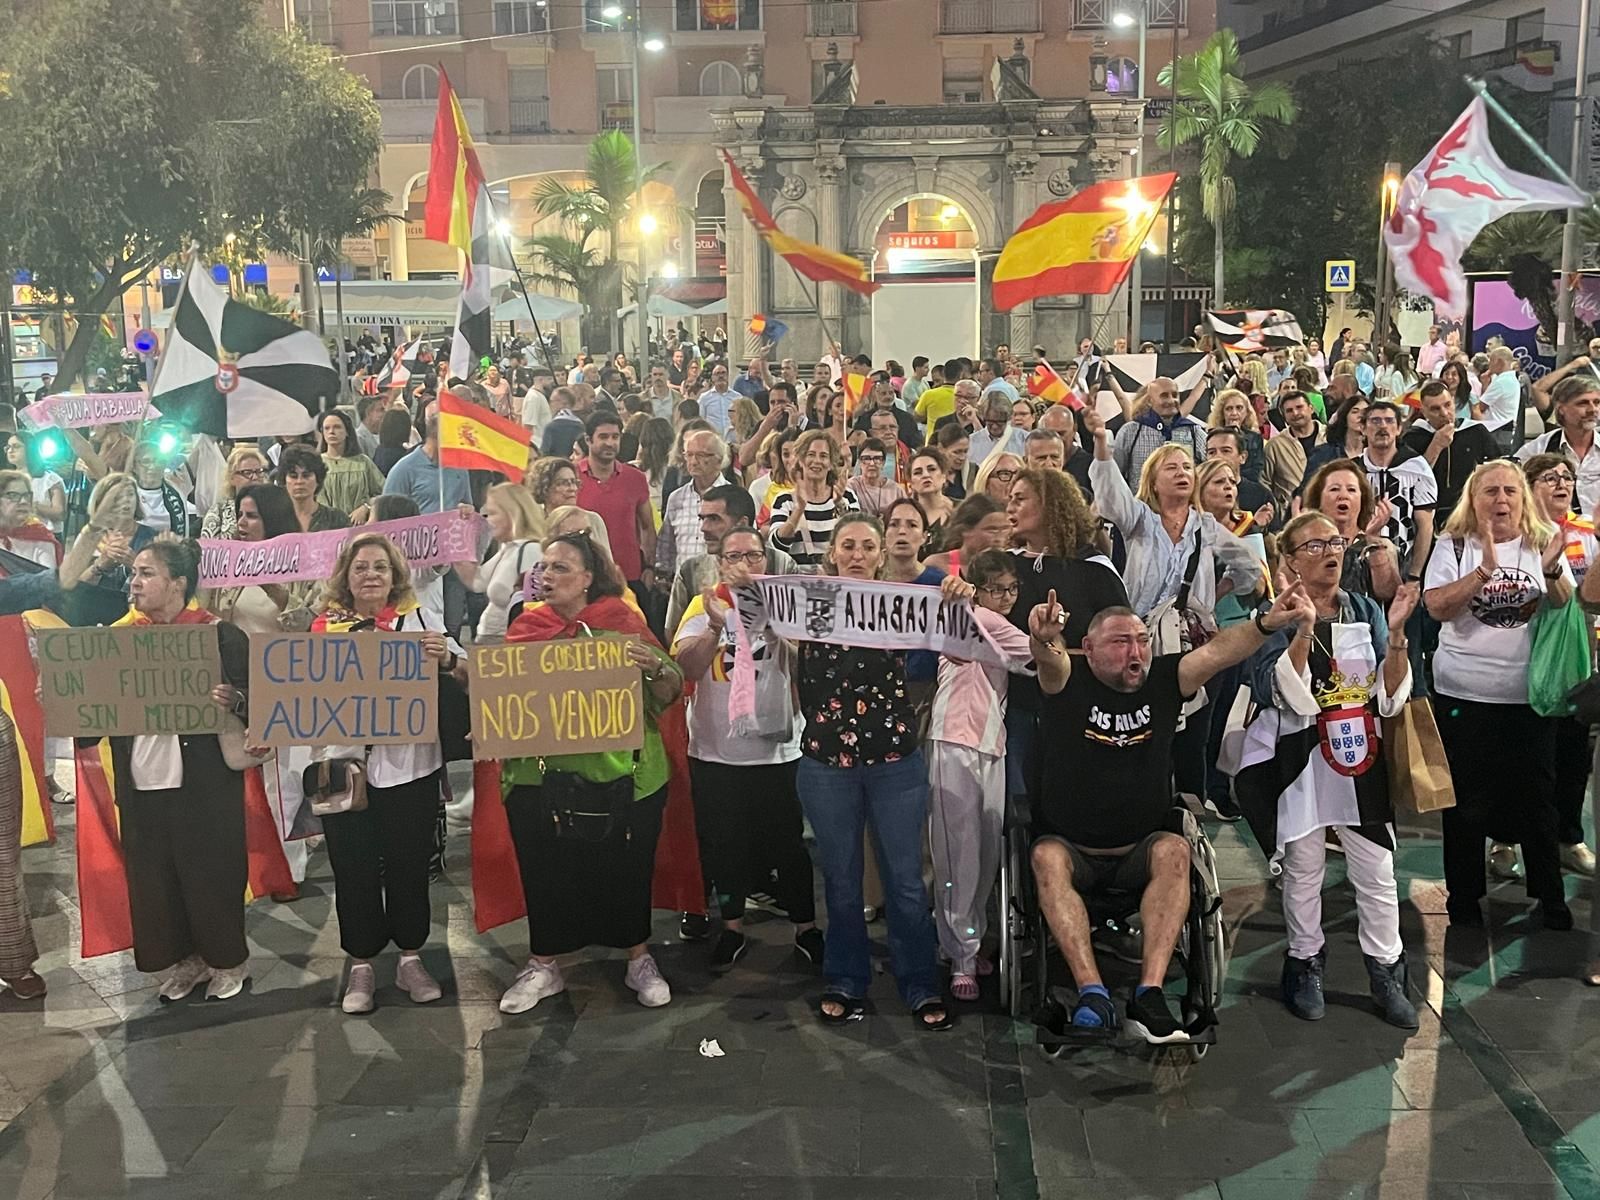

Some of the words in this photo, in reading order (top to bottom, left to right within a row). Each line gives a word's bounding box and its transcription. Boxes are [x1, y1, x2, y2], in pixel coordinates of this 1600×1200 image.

[889, 236, 939, 248] seguros
[353, 315, 401, 325] COLUMNA
[65, 400, 92, 421] UNA
[94, 399, 145, 419] CABALLA
[201, 547, 231, 578] UNA
[234, 542, 299, 578] CABALLA
[400, 524, 440, 560] RINDE
[45, 630, 121, 663] CEUTA
[133, 630, 213, 662] MERECE
[263, 638, 364, 684] CEUTA
[379, 639, 431, 681] PIDE
[477, 646, 528, 679] ESTE
[540, 640, 635, 674] GOBIERNO
[53, 669, 84, 699] UN
[119, 668, 212, 698] FUTURO
[78, 703, 118, 730] SIN
[144, 703, 218, 732] MIEDO
[263, 695, 426, 741] AUXILIO
[480, 690, 541, 742] NOS
[550, 680, 637, 742] VENDIÓ
[1088, 705, 1112, 730] SIS
